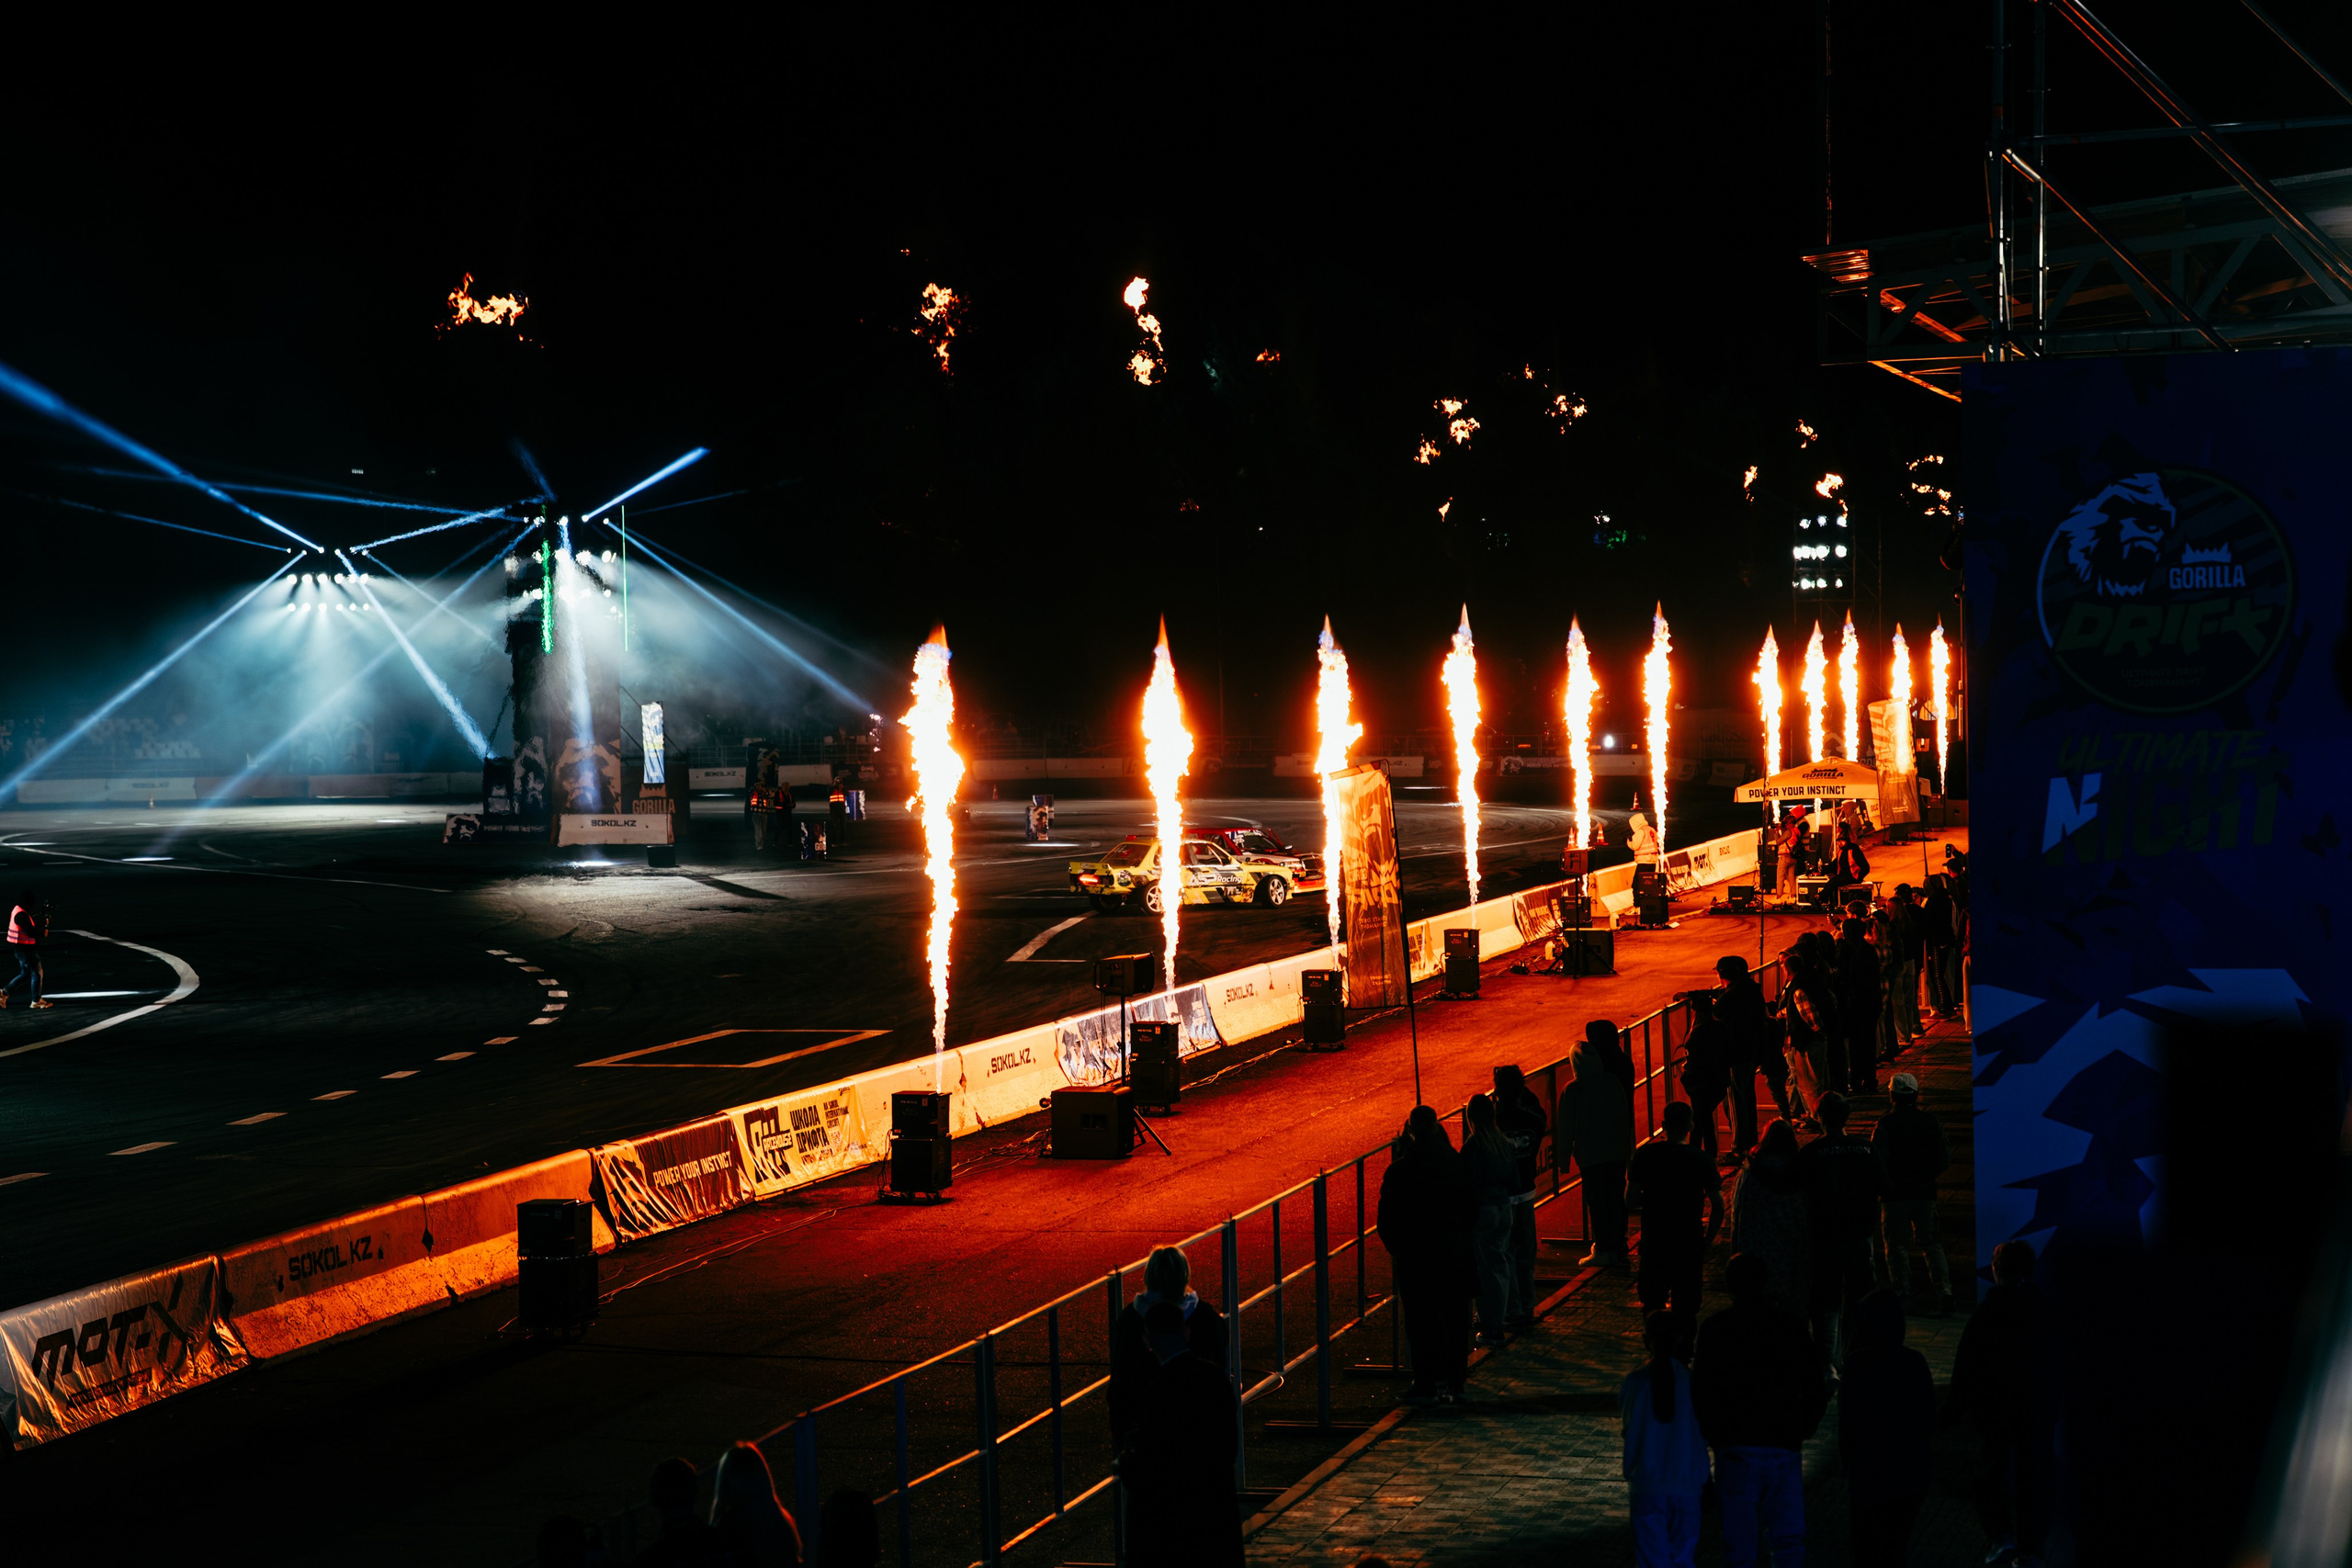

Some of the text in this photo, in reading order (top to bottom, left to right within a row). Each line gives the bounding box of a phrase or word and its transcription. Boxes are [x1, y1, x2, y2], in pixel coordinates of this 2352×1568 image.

[2169, 565, 2246, 591] GORILLA
[2052, 597, 2273, 659] DRIFT
[2058, 730, 2267, 773] ULTIMATE
[1782, 786, 1804, 796] YOUR
[1807, 785, 1846, 795] INSTINCT
[632, 798, 675, 815] GORILLA
[2041, 753, 2291, 866] NIGHT
[1217, 874, 1242, 883] Racing
[991, 1047, 1031, 1074] SOKOL.KZ
[789, 1105, 820, 1131] ШКОЛА
[796, 1126, 830, 1154] ДРИФТА
[1818, 1145, 1871, 1156] MUTATION
[652, 1150, 732, 1190] POWER YOUR INSTINCT
[31, 1271, 187, 1391] MOT-X
